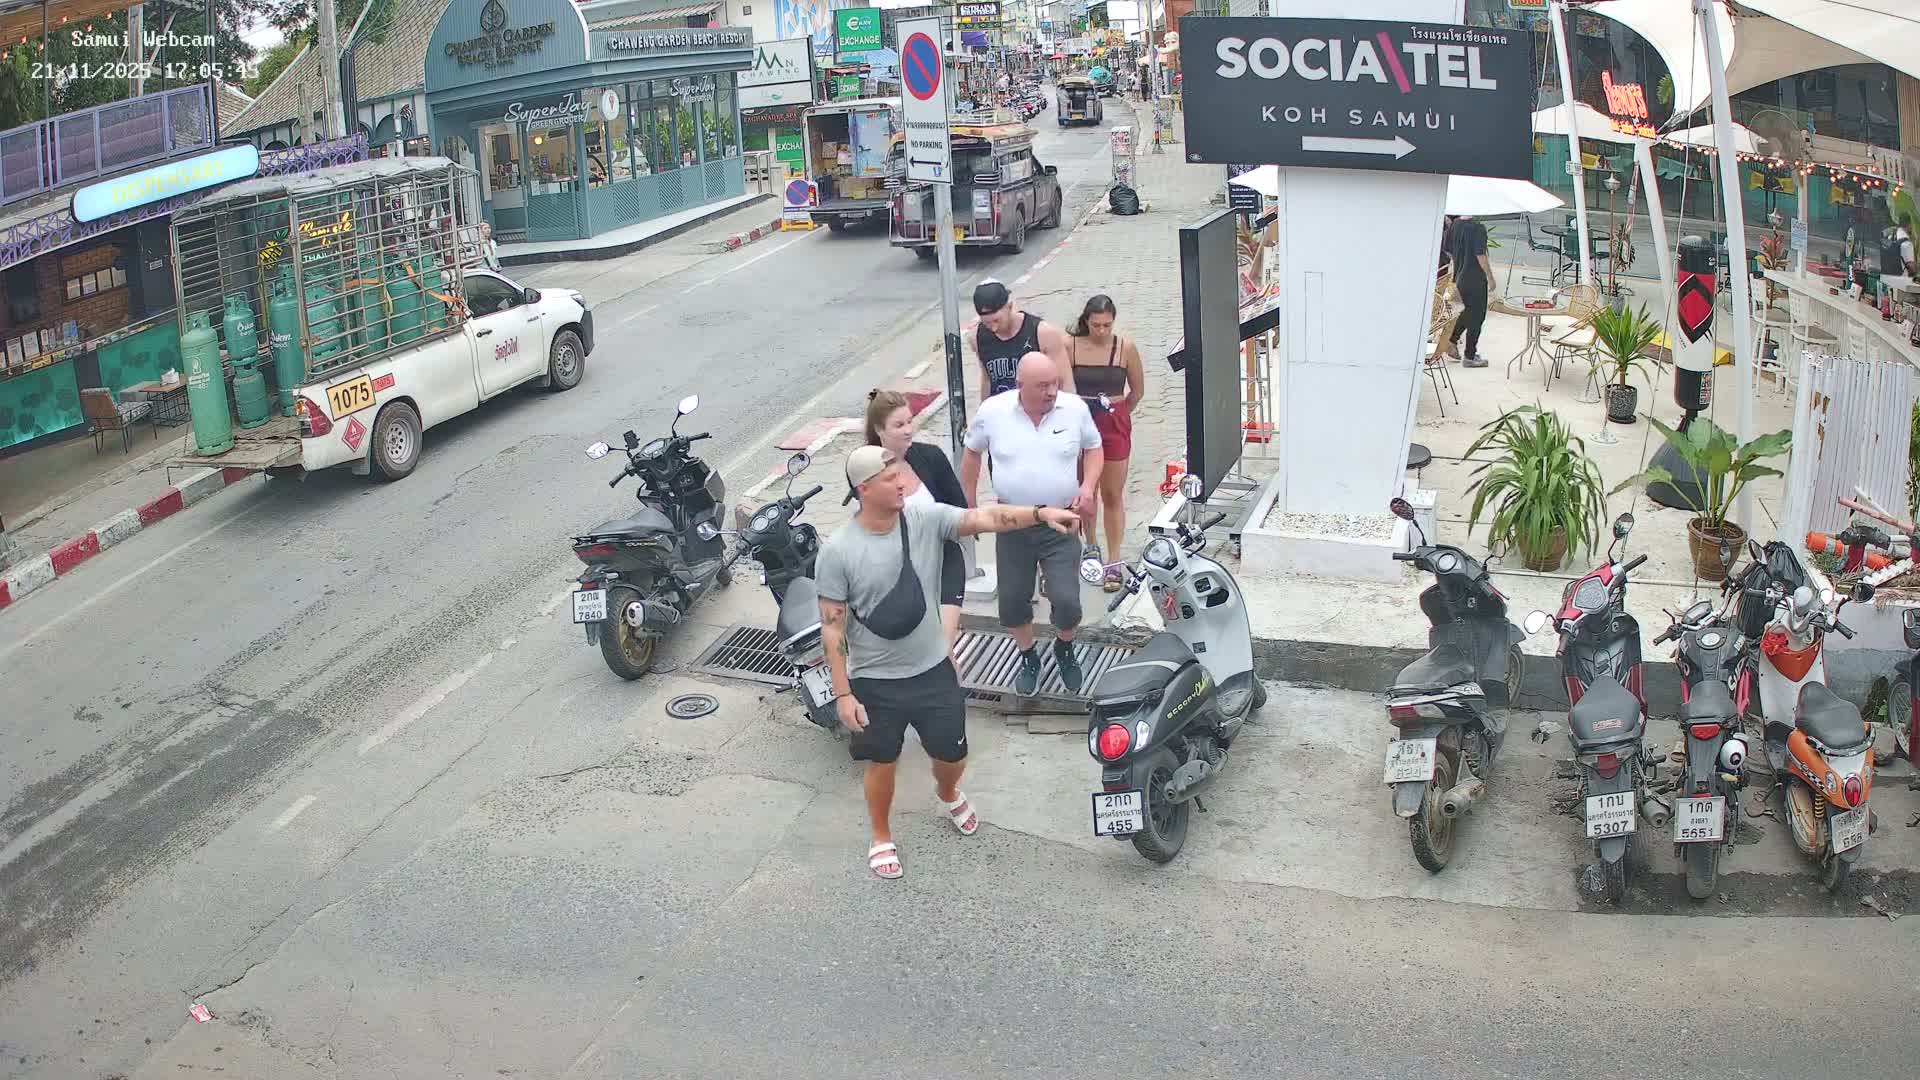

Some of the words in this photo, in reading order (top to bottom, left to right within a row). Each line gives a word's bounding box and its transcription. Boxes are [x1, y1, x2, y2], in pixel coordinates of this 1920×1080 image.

[503, 22, 556, 43] GARDEN
[1411, 26, 1507, 45] โรงแรมโซเชียลเทล
[611, 35, 654, 49] CHAWENG
[657, 34, 692, 48] GARDEN
[693, 33, 718, 46] BEACH
[719, 32, 747, 45] RESORT
[839, 35, 880, 46] EXCHANGE
[741, 67, 800, 79] CHAWENG
[1261, 105, 1327, 124] KOH
[1349, 108, 1455, 131] SAMUI
[910, 140, 919, 149] NO
[919, 140, 943, 150] PARKING
[113, 160, 225, 205] DISPENSARY
[333, 381, 370, 412] 1075
[578, 610, 603, 621] 7840
[1598, 794, 1624, 808] 1กบ
[1107, 819, 1133, 833] 455
[1593, 820, 1629, 835] 5307
[1681, 828, 1713, 838] 5651
